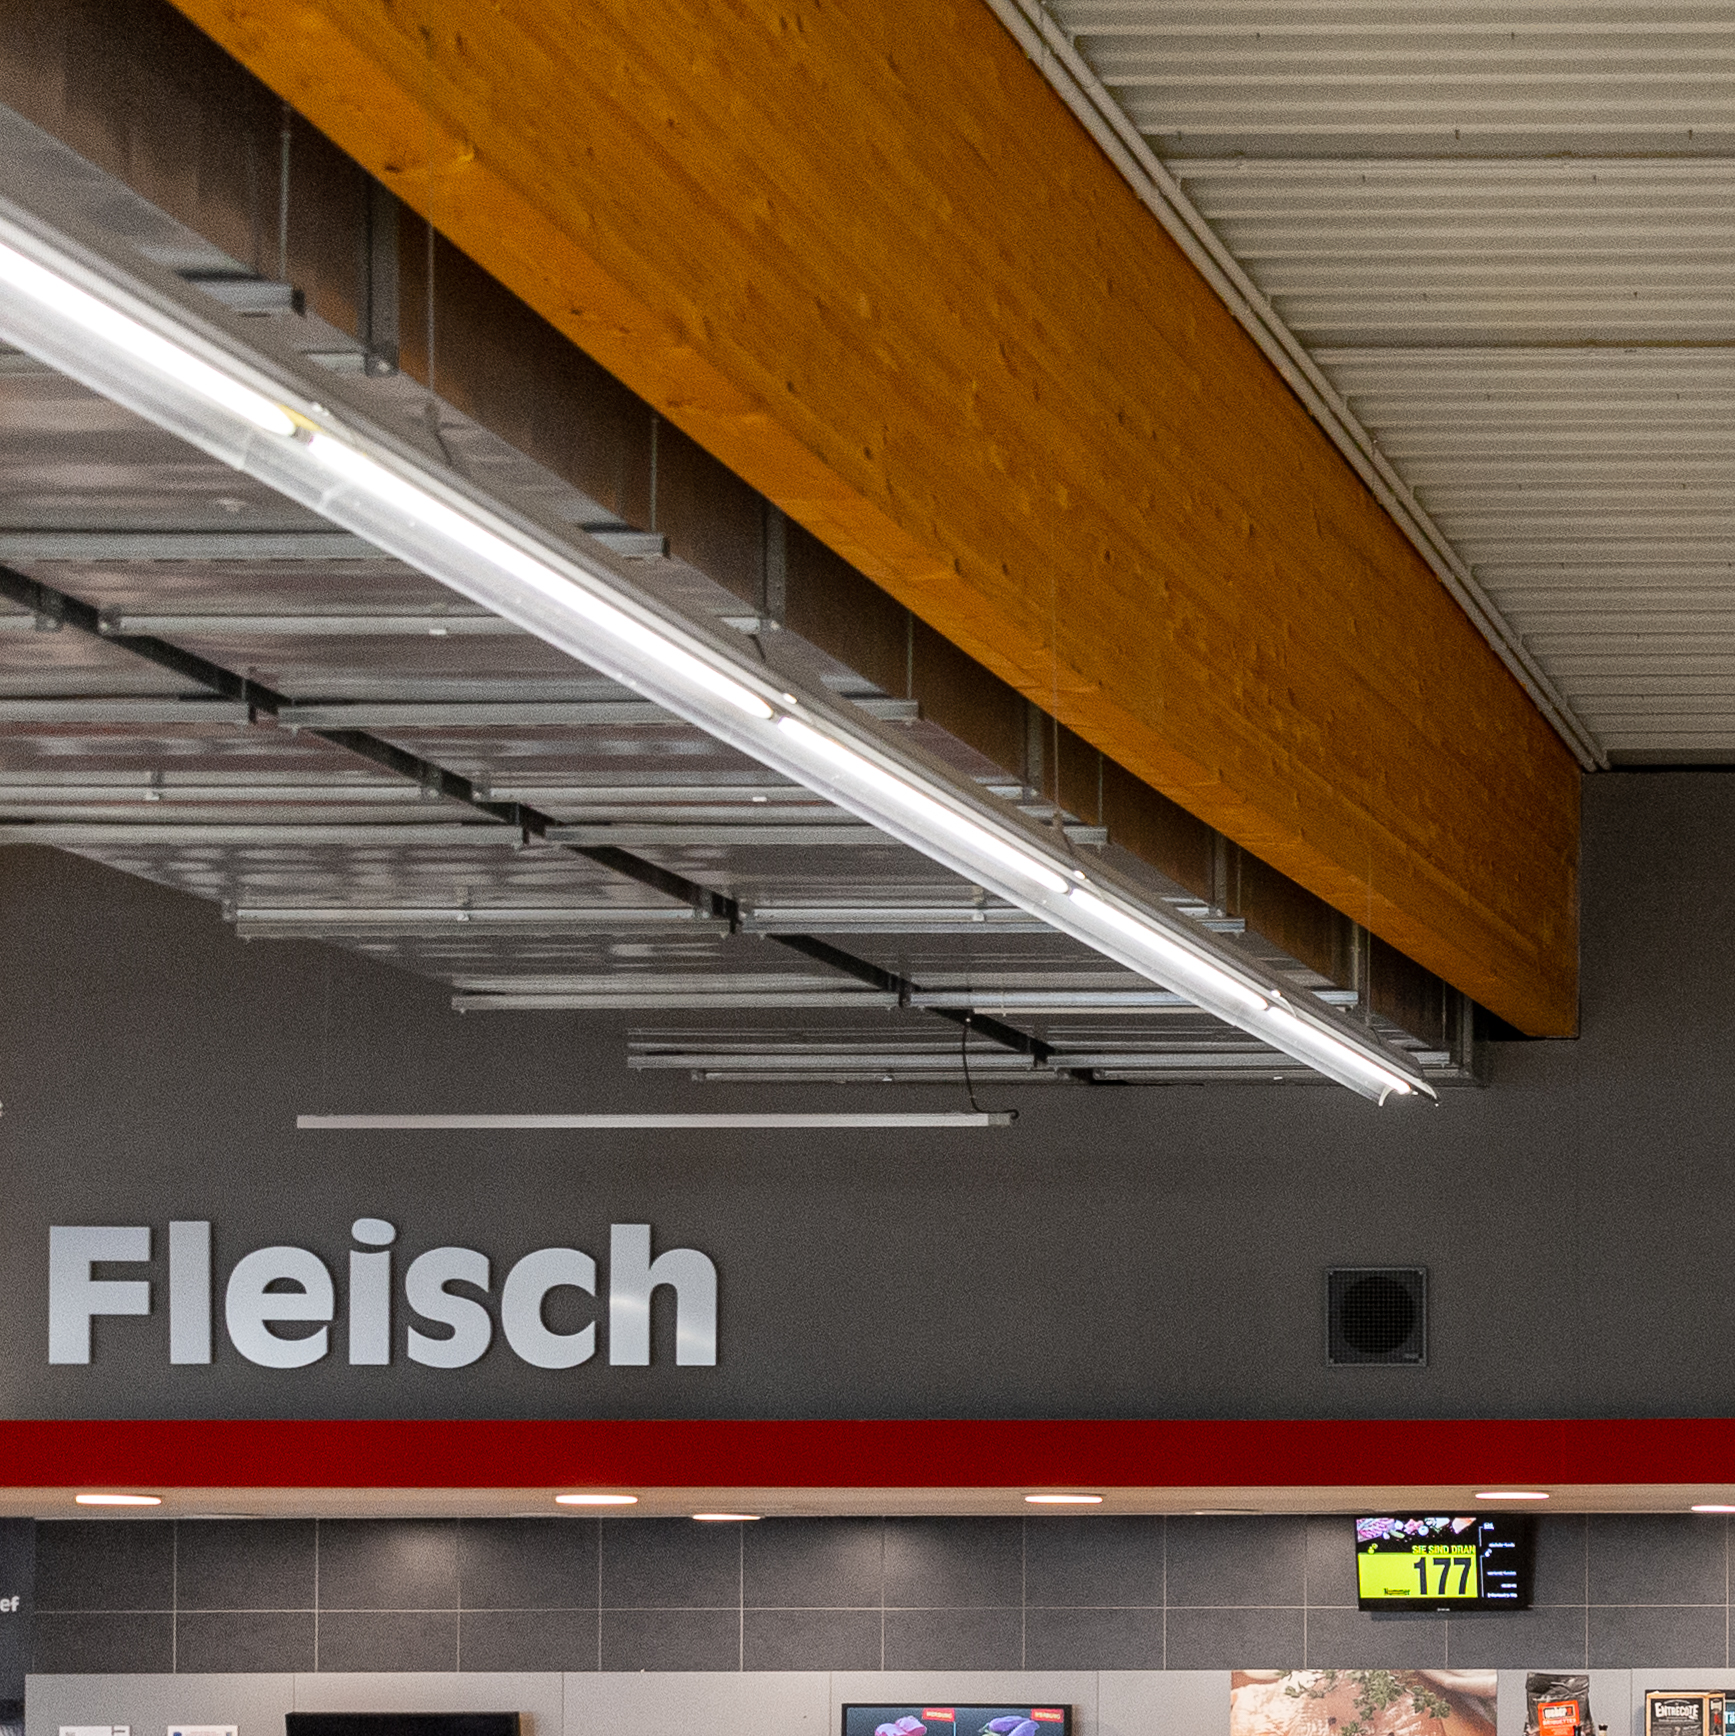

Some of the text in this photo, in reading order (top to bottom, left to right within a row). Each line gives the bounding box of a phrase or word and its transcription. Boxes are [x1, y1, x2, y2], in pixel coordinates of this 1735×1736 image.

[49, 1218, 718, 1369] Fleisch
[1412, 1545, 1476, 1555] SIE SIND DRAN
[1414, 1557, 1472, 1595] 177
